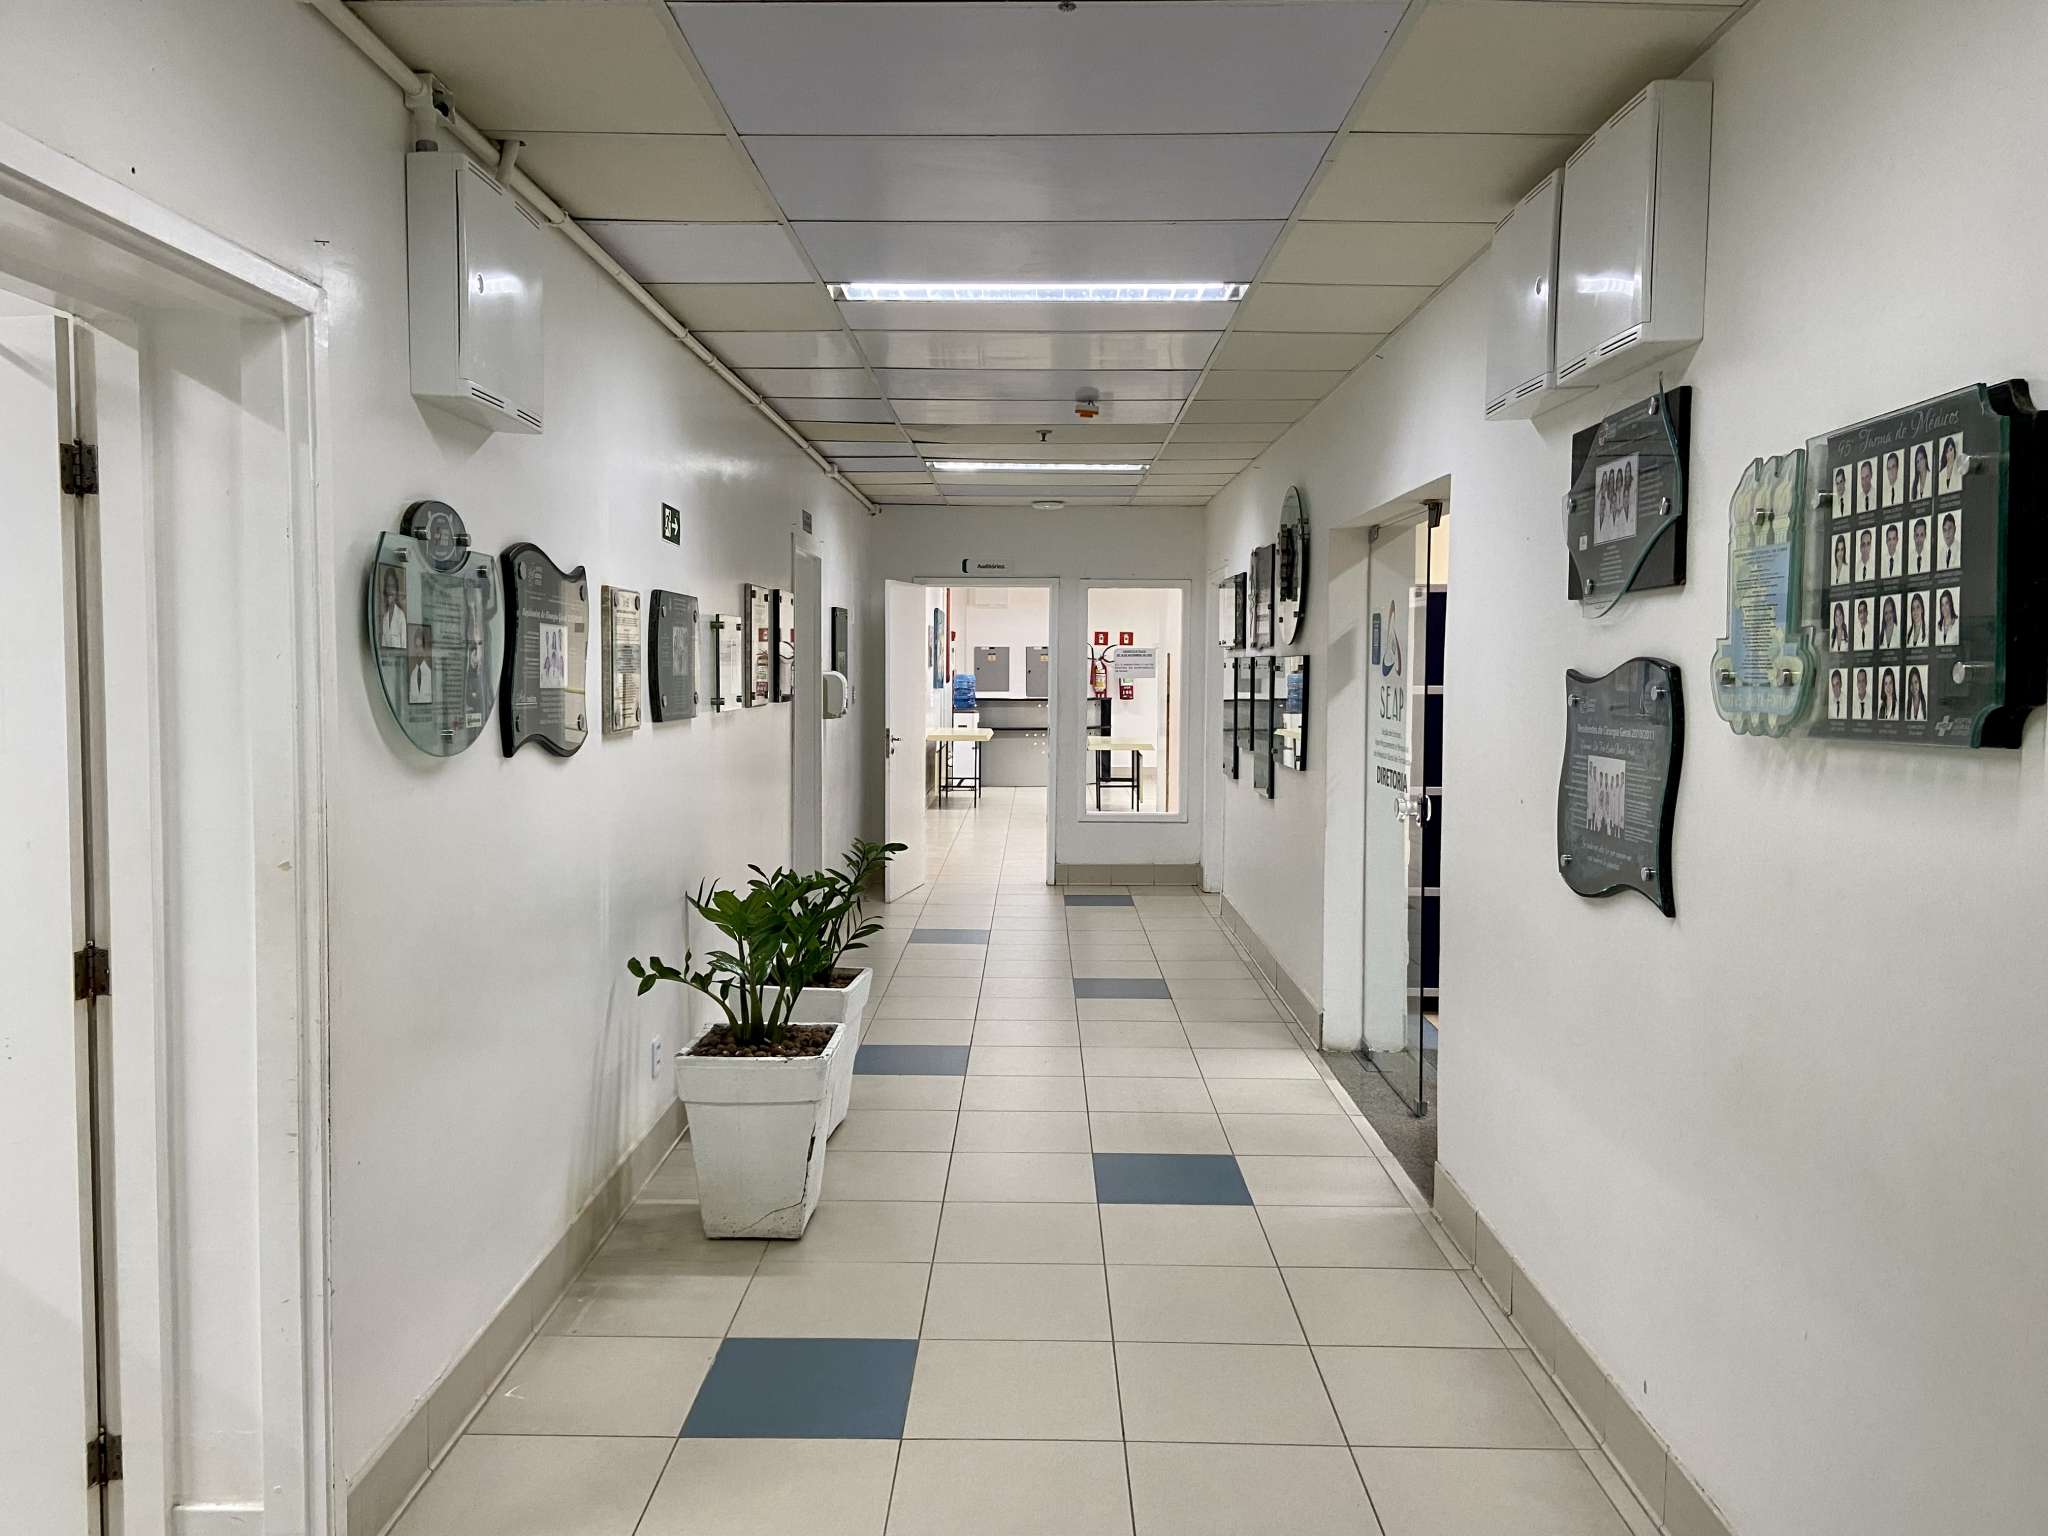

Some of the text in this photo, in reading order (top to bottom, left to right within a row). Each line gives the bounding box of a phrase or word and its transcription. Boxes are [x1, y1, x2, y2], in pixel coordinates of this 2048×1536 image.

[1858, 428, 1891, 452] Turma
[1895, 423, 1907, 440] de
[1910, 407, 1960, 438] Médicos
[1380, 686, 1404, 722] SEAP
[1376, 765, 1408, 794] DIRETORIA
